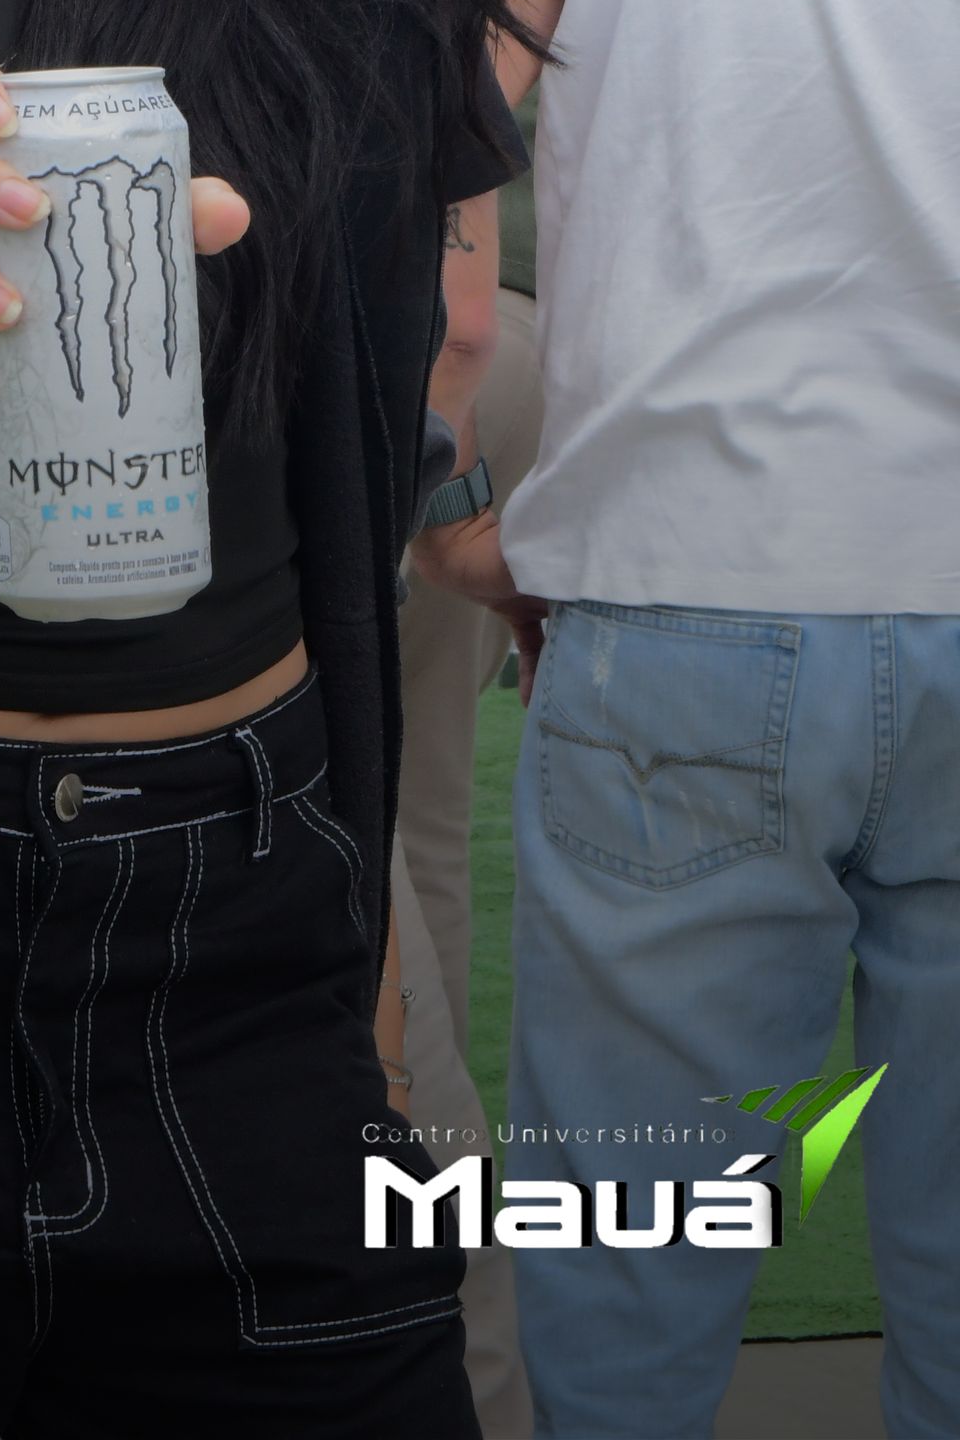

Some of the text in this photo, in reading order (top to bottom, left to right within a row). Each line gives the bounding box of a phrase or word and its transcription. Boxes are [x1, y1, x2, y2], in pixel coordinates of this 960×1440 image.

[8, 443, 205, 496] MONSTER
[41, 491, 199, 522] ENERGY
[87, 528, 165, 547] ULTRA
